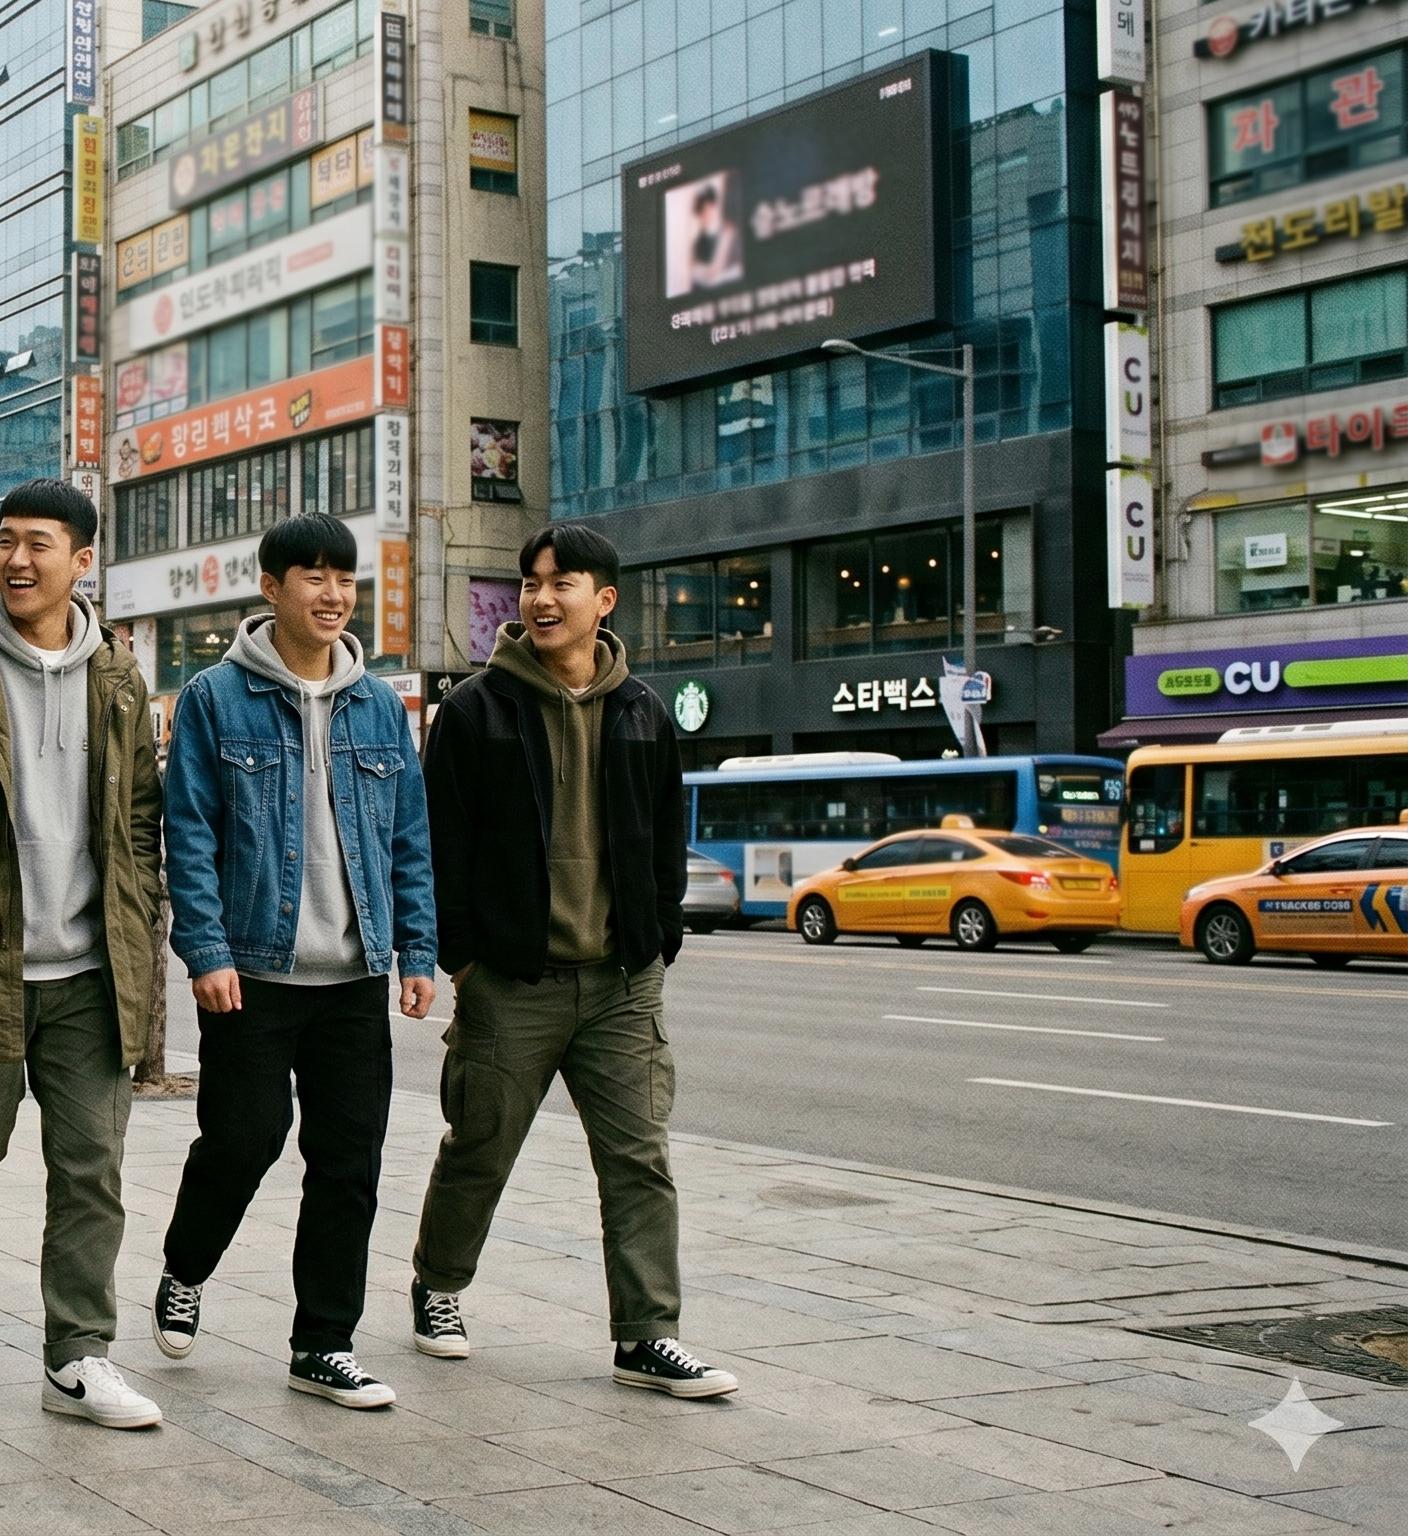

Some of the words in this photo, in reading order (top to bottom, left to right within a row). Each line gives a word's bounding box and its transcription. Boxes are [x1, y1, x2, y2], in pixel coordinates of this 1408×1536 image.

[1124, 357, 1143, 416] CU
[1126, 501, 1145, 561] CU
[1224, 660, 1280, 695] CU
